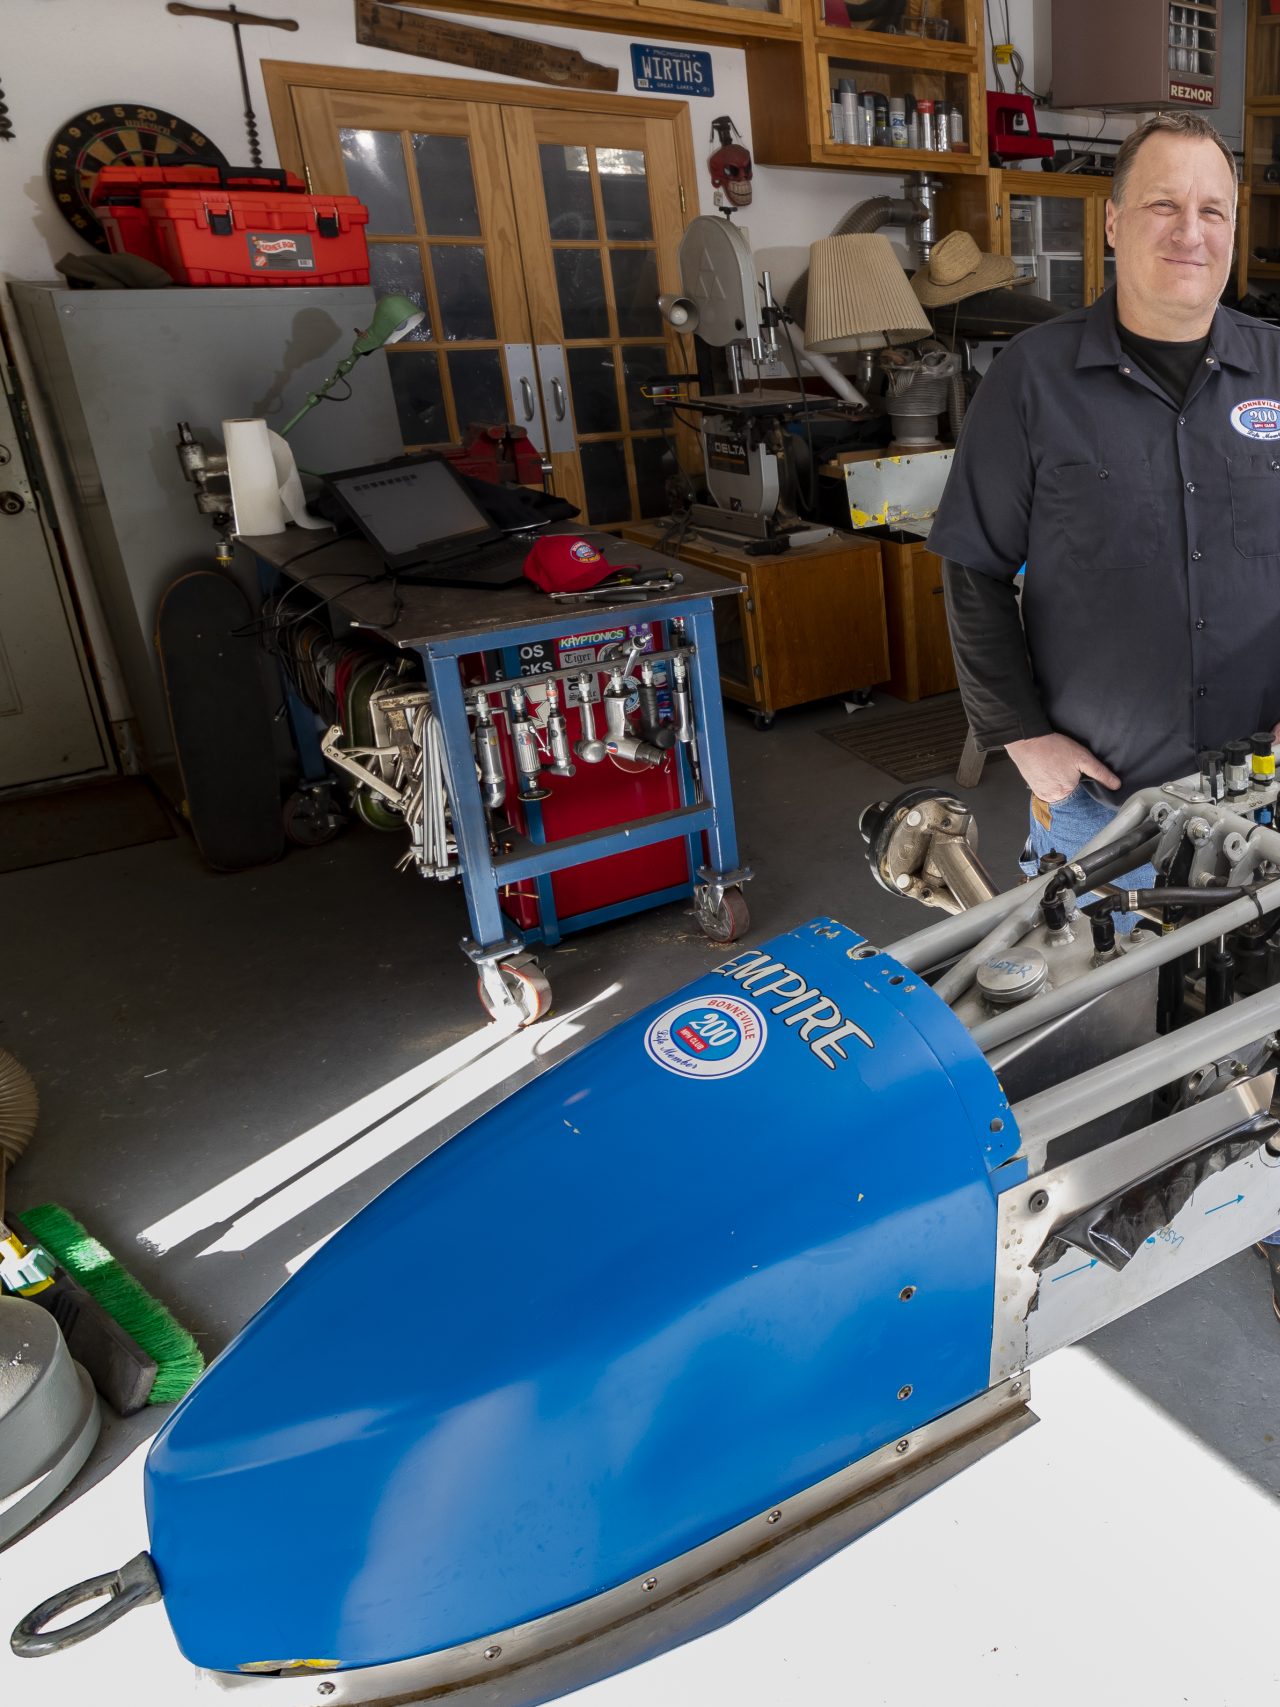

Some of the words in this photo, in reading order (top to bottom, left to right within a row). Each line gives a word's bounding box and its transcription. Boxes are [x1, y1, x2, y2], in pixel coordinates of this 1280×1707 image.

[642, 55, 703, 83] WIRTHS
[1170, 84, 1213, 103] REZNOR
[86, 111, 105, 125] 12
[113, 106, 126, 118] 5
[136, 108, 157, 121] 20
[68, 127, 82, 139] 9
[55, 143, 70, 159] 14
[53, 168, 67, 181] 11
[58, 193, 72, 203] 8
[71, 213, 88, 229] 16
[1249, 410, 1277, 423] 200
[714, 442, 746, 457] DELTA
[559, 629, 625, 649] KRYPTONICS
[564, 651, 592, 664] Tiger
[711, 950, 875, 1070] EMPIRE
[707, 999, 756, 1040] BONNEVILLE
[653, 1029, 669, 1044] Life
[688, 1013, 737, 1046] 200
[680, 1027, 692, 1039] MPH
[689, 1037, 705, 1050] CLUB
[660, 1046, 698, 1069] Member
